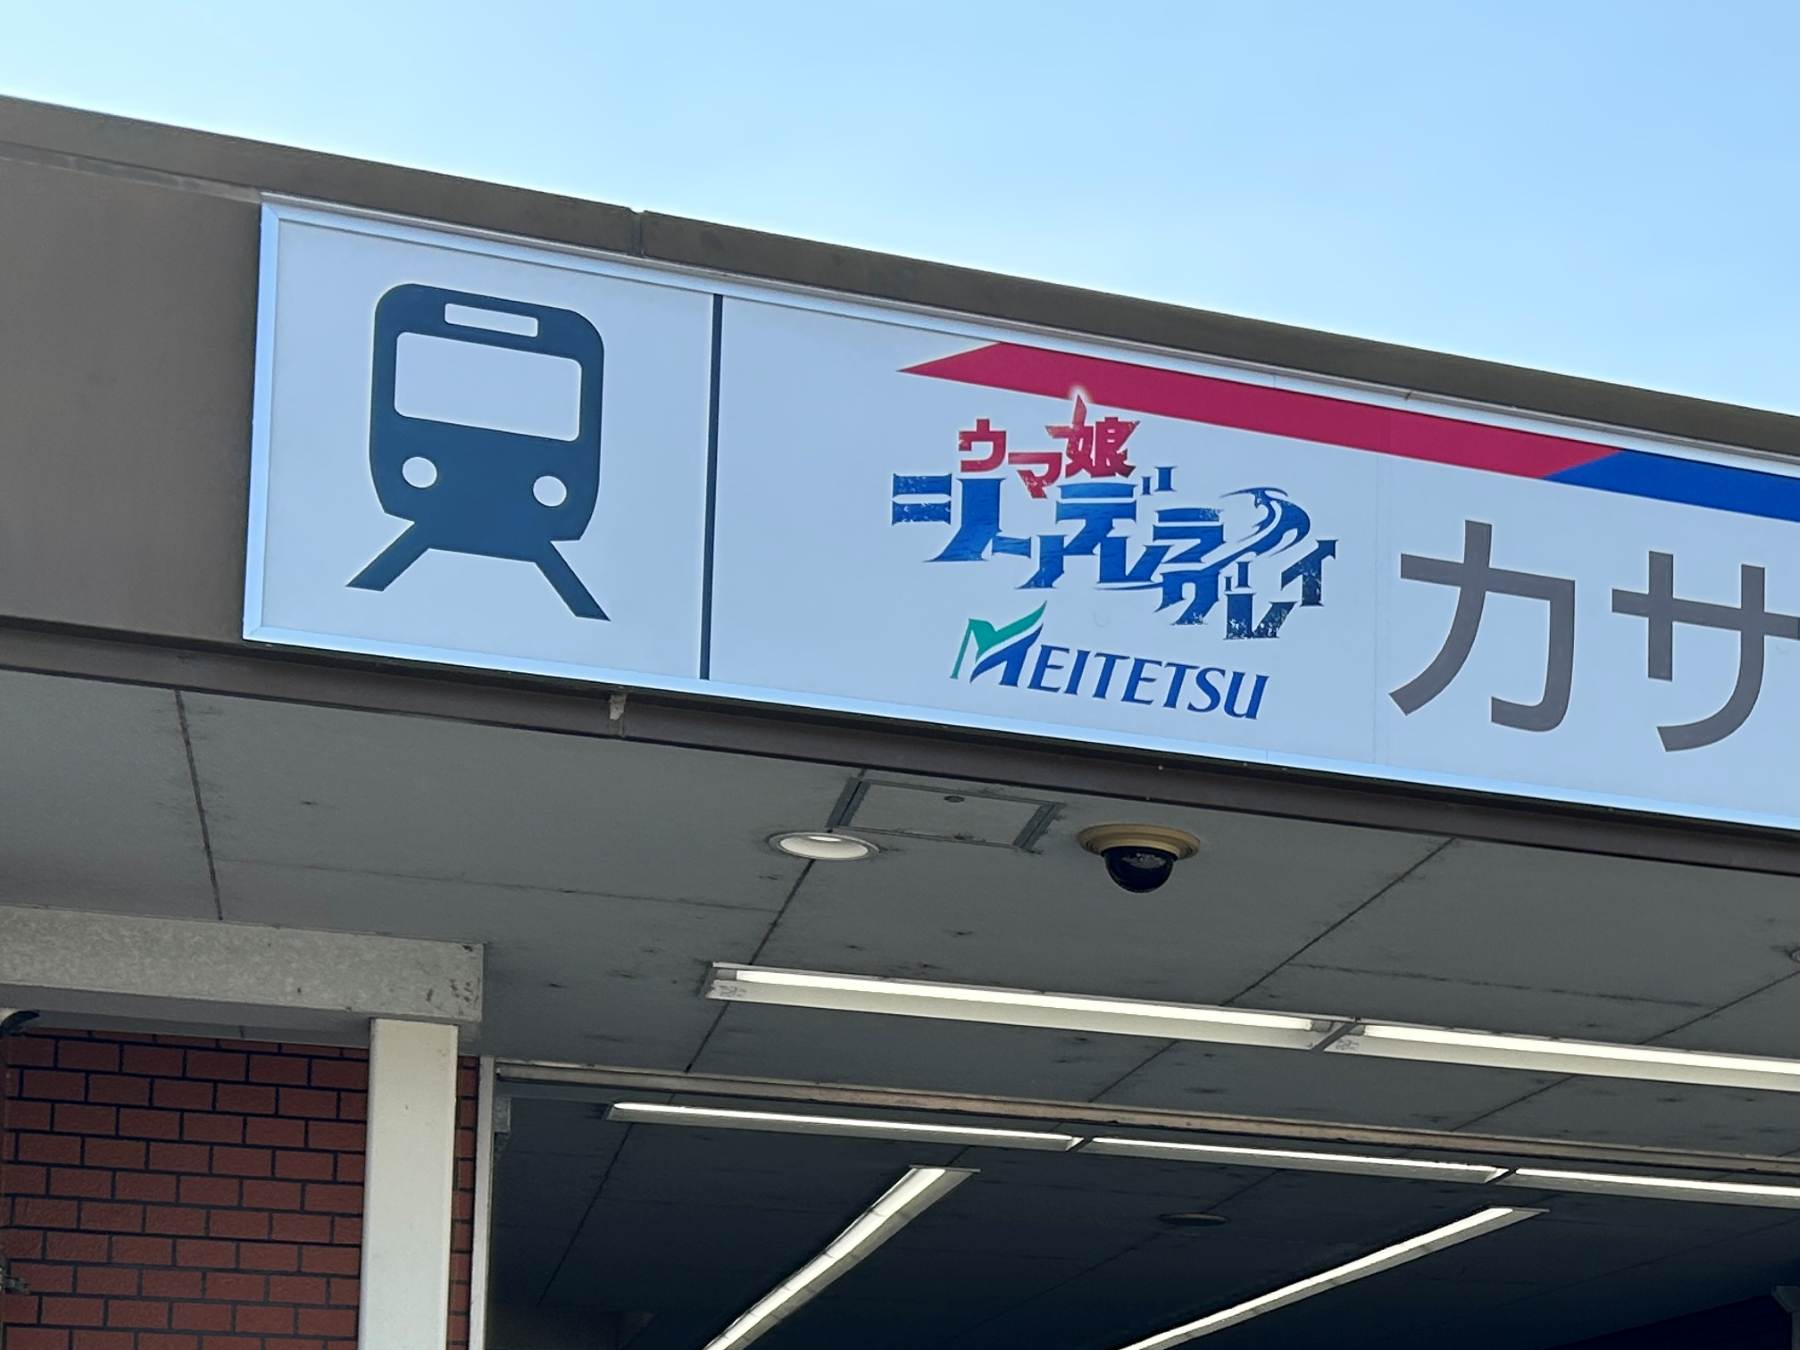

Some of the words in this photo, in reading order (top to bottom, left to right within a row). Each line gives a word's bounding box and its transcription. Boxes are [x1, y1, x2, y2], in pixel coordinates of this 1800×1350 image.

[958, 395, 1139, 499] ウマ娘
[950, 601, 1269, 721] MEITETSU
